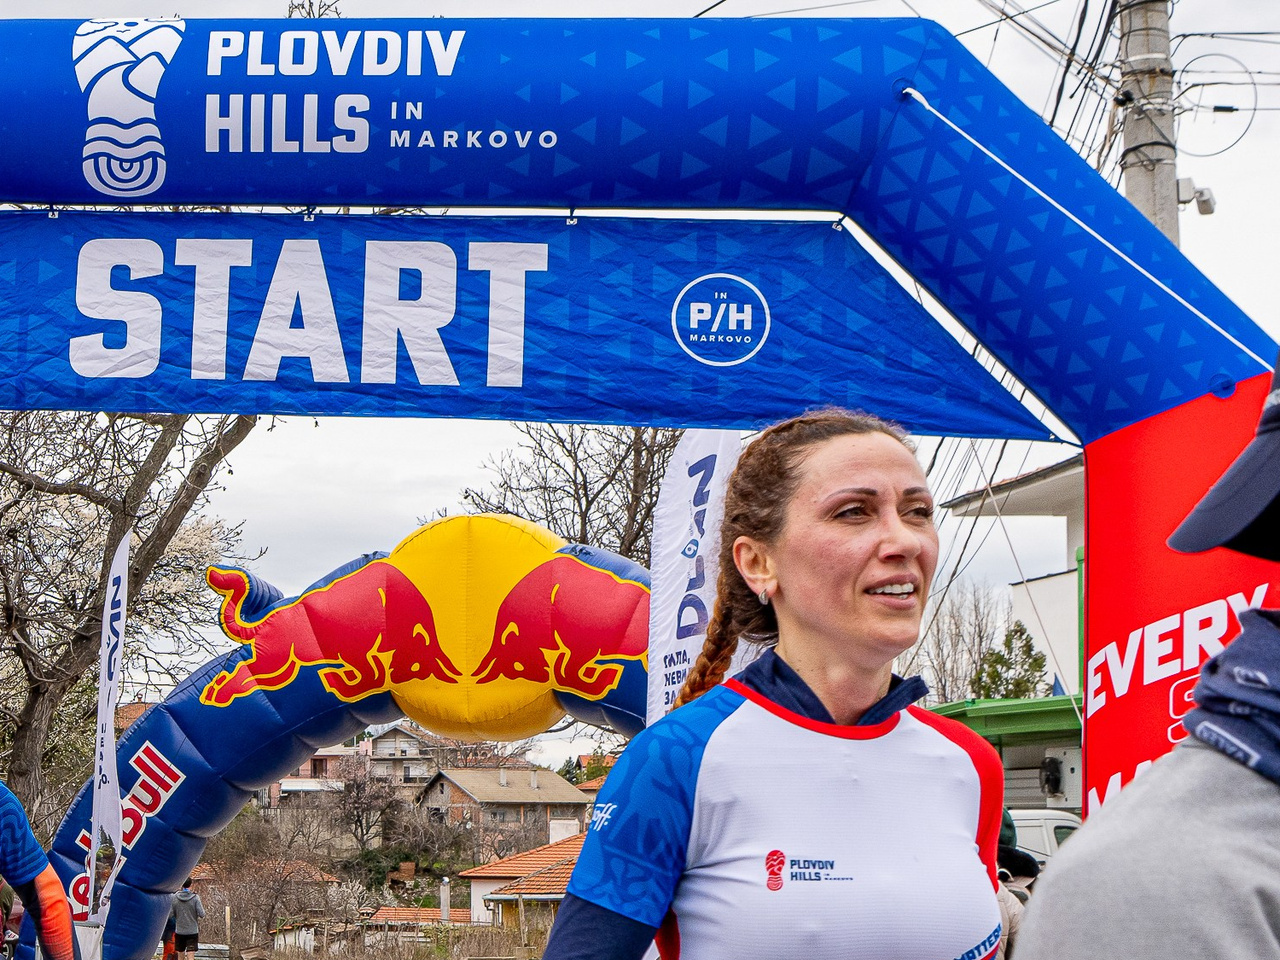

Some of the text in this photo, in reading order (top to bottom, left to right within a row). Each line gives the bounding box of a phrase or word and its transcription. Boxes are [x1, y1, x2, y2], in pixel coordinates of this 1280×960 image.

[205, 31, 466, 76] PLOVDIV
[391, 102, 423, 120] IN
[205, 94, 371, 153] HILLS
[390, 129, 559, 149] MARKOVO
[714, 291, 727, 299] IN
[69, 238, 548, 388] START
[689, 302, 752, 332] P/H
[689, 334, 752, 343] MARKOVO
[1087, 583, 1269, 719] EVERY
[790, 859, 835, 870] PLOVDIV
[790, 871, 822, 881] HILLS
